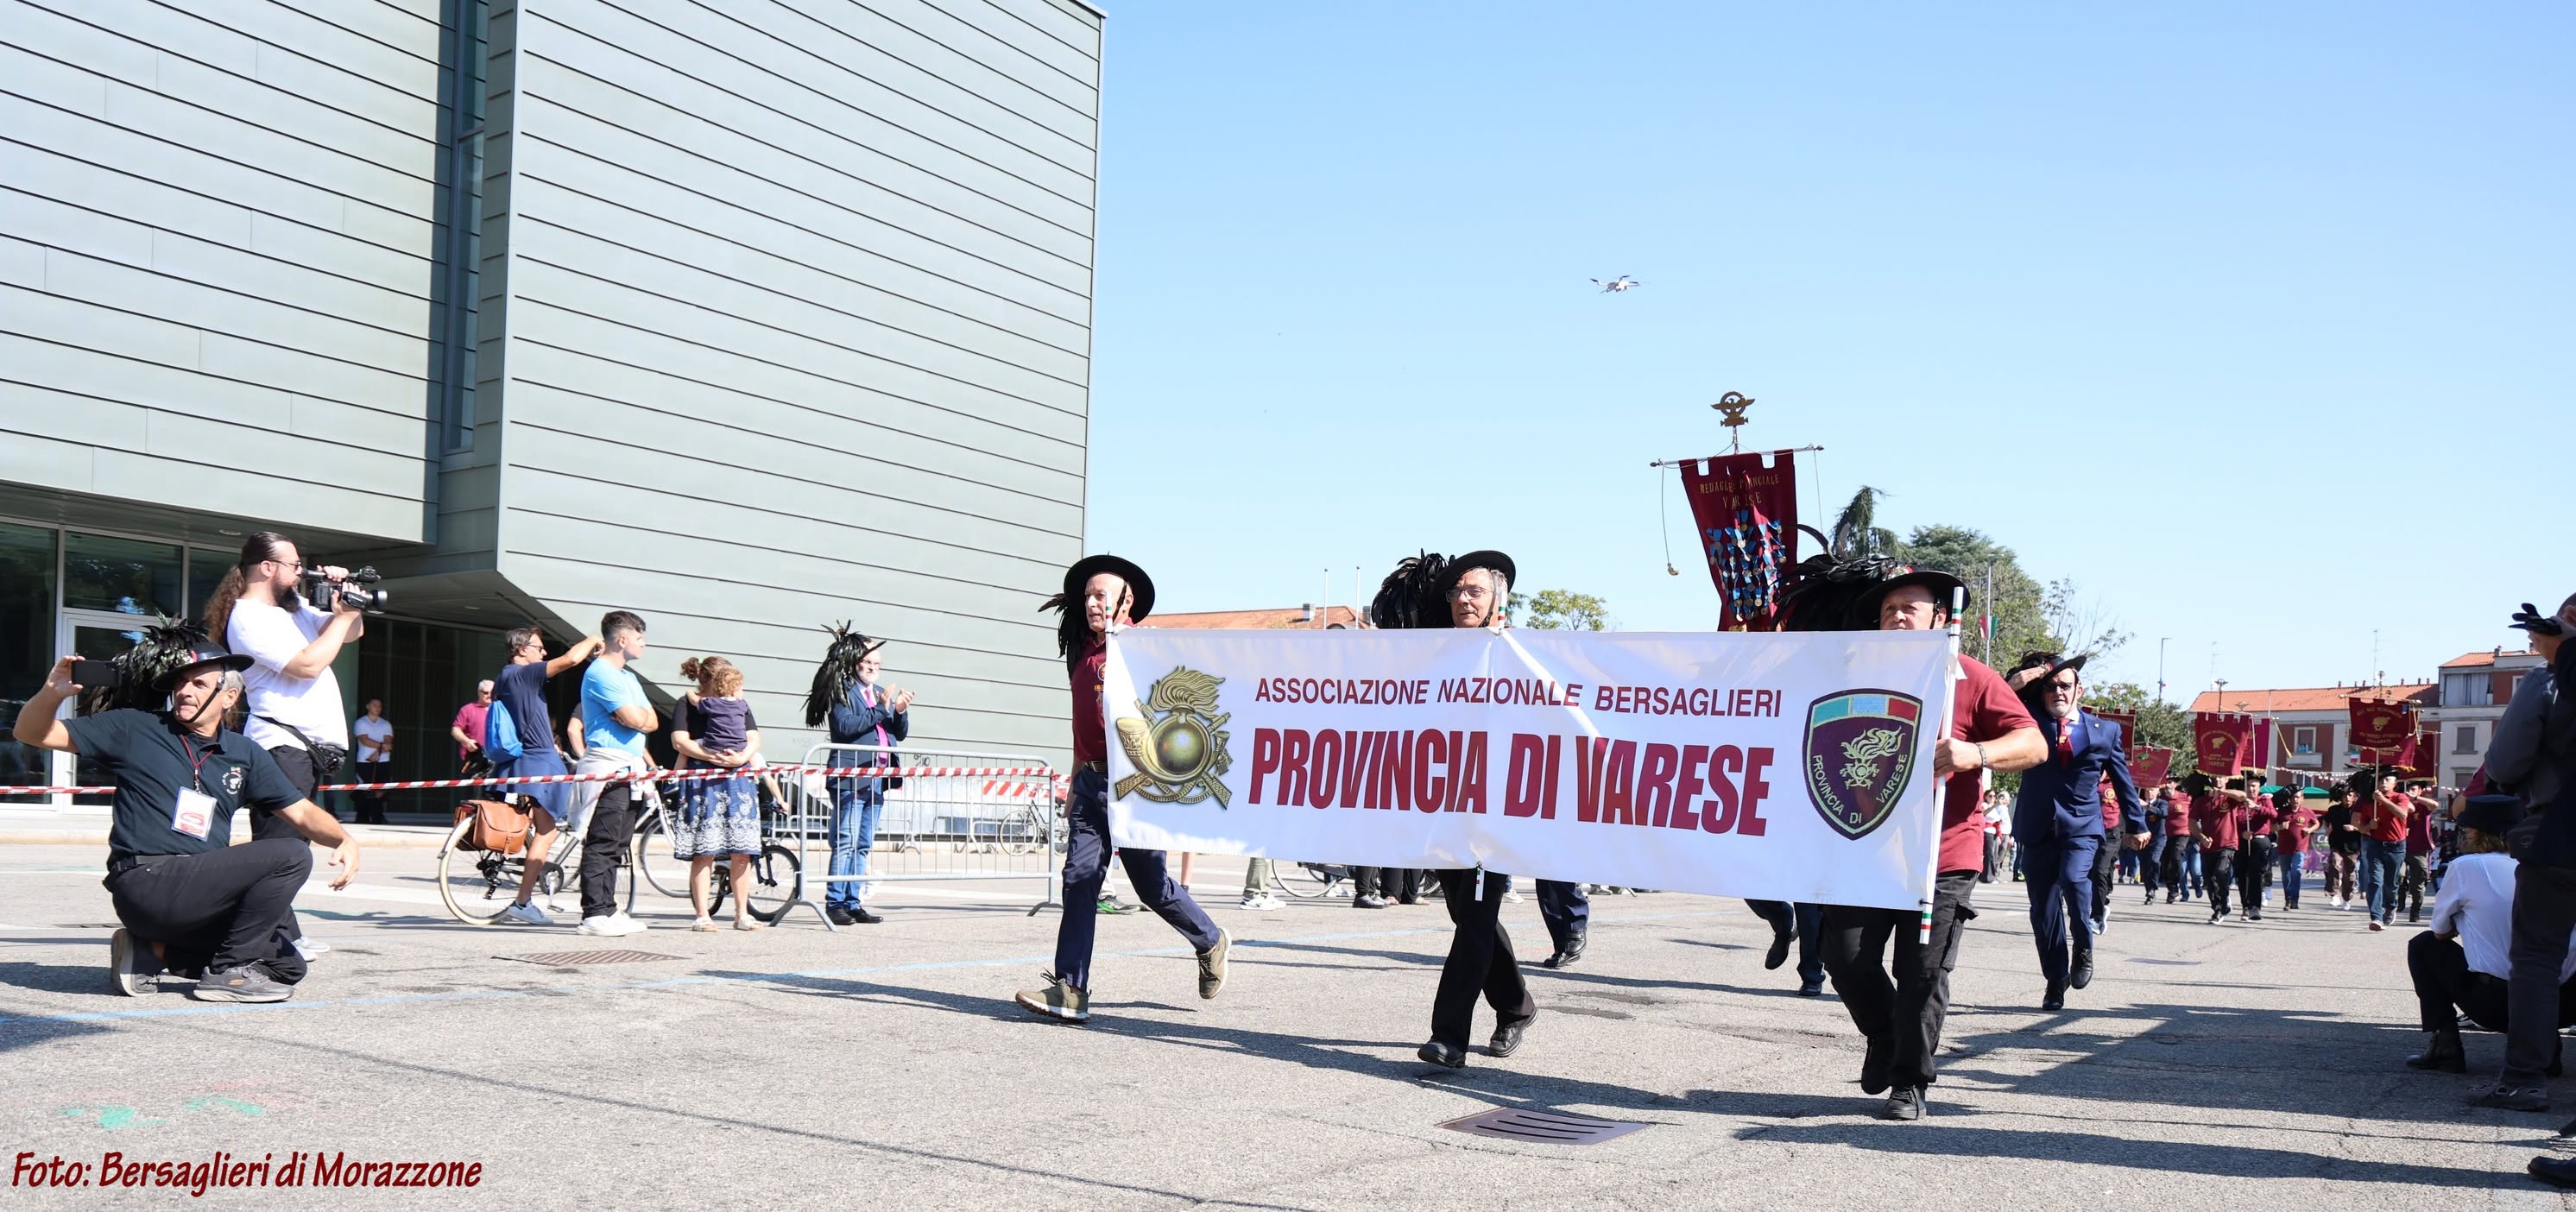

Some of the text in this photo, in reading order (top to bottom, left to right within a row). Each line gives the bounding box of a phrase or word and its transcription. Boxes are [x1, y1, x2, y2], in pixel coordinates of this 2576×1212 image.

[1256, 678, 1782, 717] ASSOCIAZIONE NAZIONALE BERSAGLIERI
[1248, 728, 1775, 836] PROVINCIA DI VARESE
[1813, 754, 1907, 824] PROVINCIA DI VARESE
